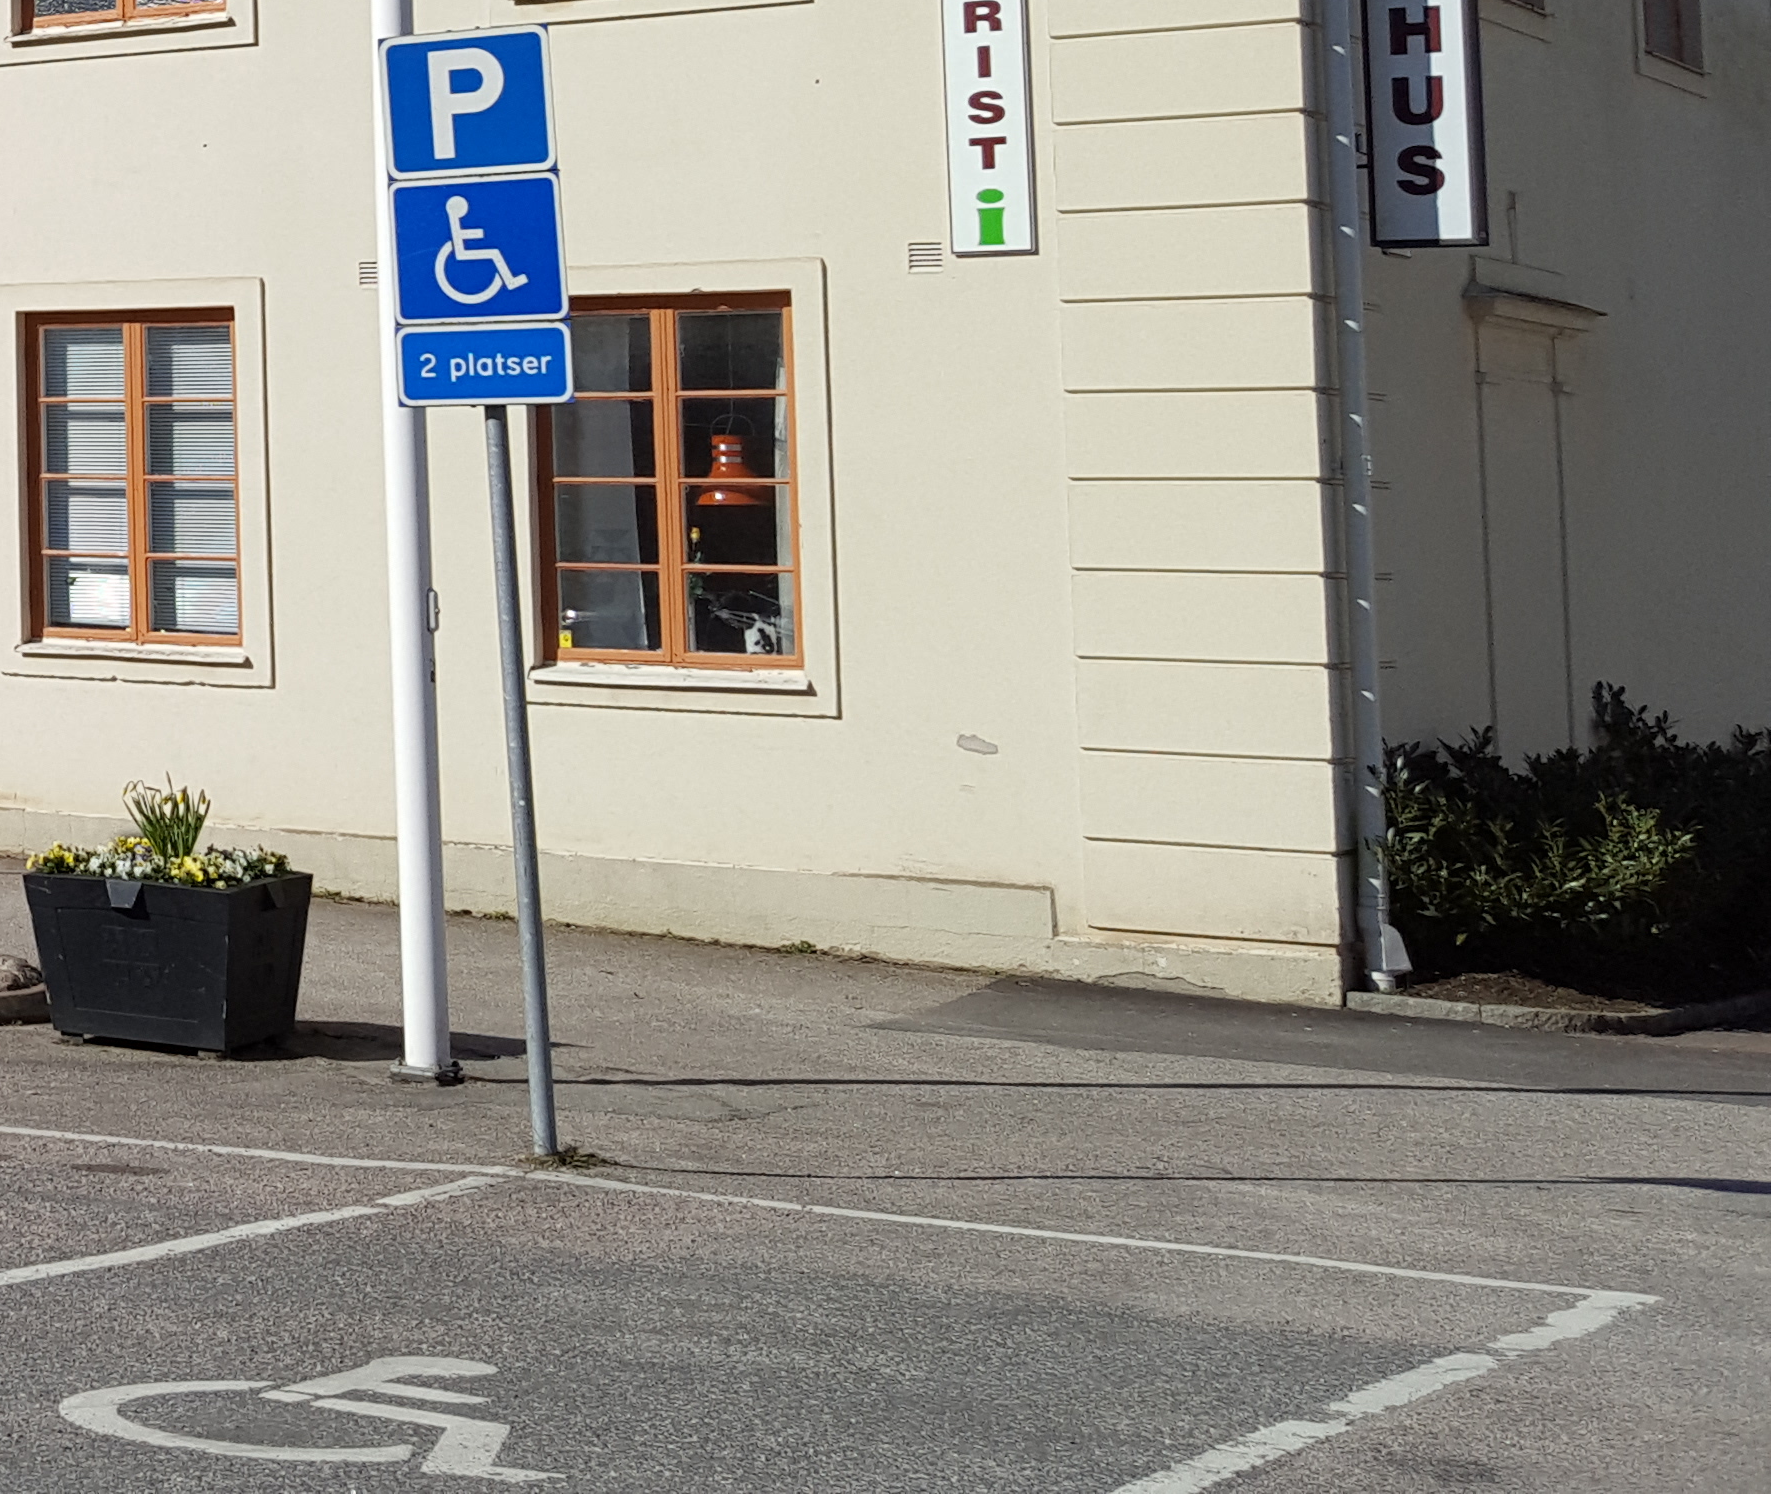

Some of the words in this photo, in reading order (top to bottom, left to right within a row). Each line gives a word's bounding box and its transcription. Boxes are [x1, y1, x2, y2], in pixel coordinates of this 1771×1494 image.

[427, 47, 505, 160] P
[420, 353, 437, 378] 2
[450, 352, 552, 382] platser
